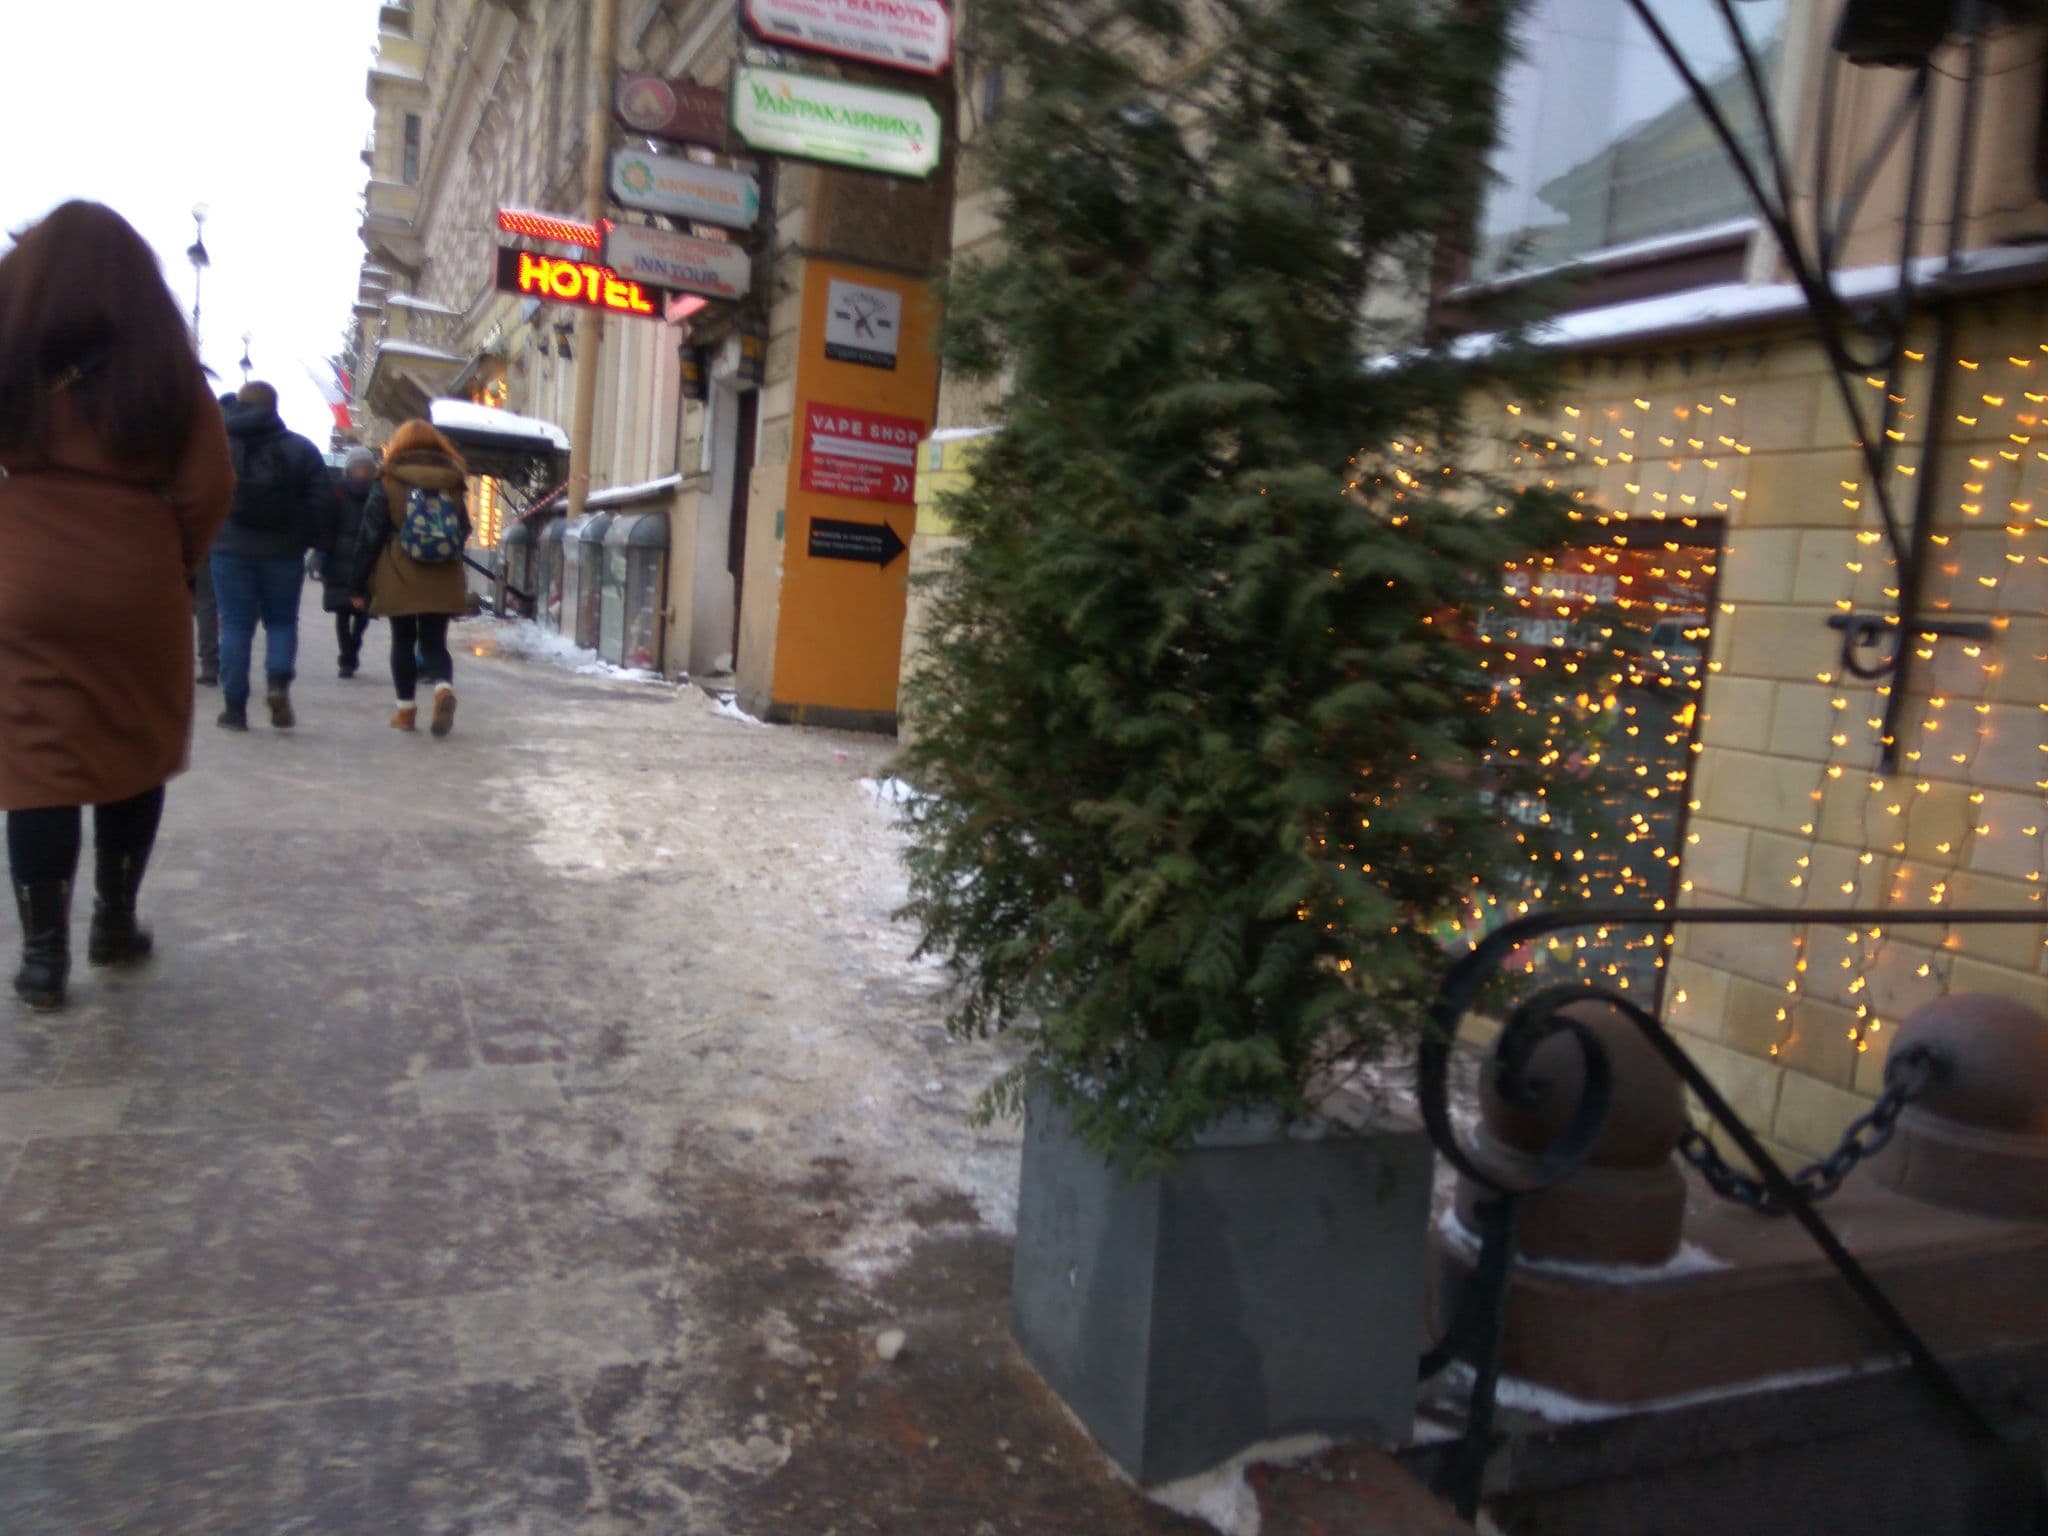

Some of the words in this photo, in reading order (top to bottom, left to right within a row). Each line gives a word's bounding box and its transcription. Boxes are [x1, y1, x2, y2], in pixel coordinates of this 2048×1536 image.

[519, 252, 654, 312] HOTEL
[634, 255, 668, 274] INN
[670, 263, 720, 284] TOUR
[812, 415, 863, 436] VAPE
[870, 423, 919, 444] SHOP
